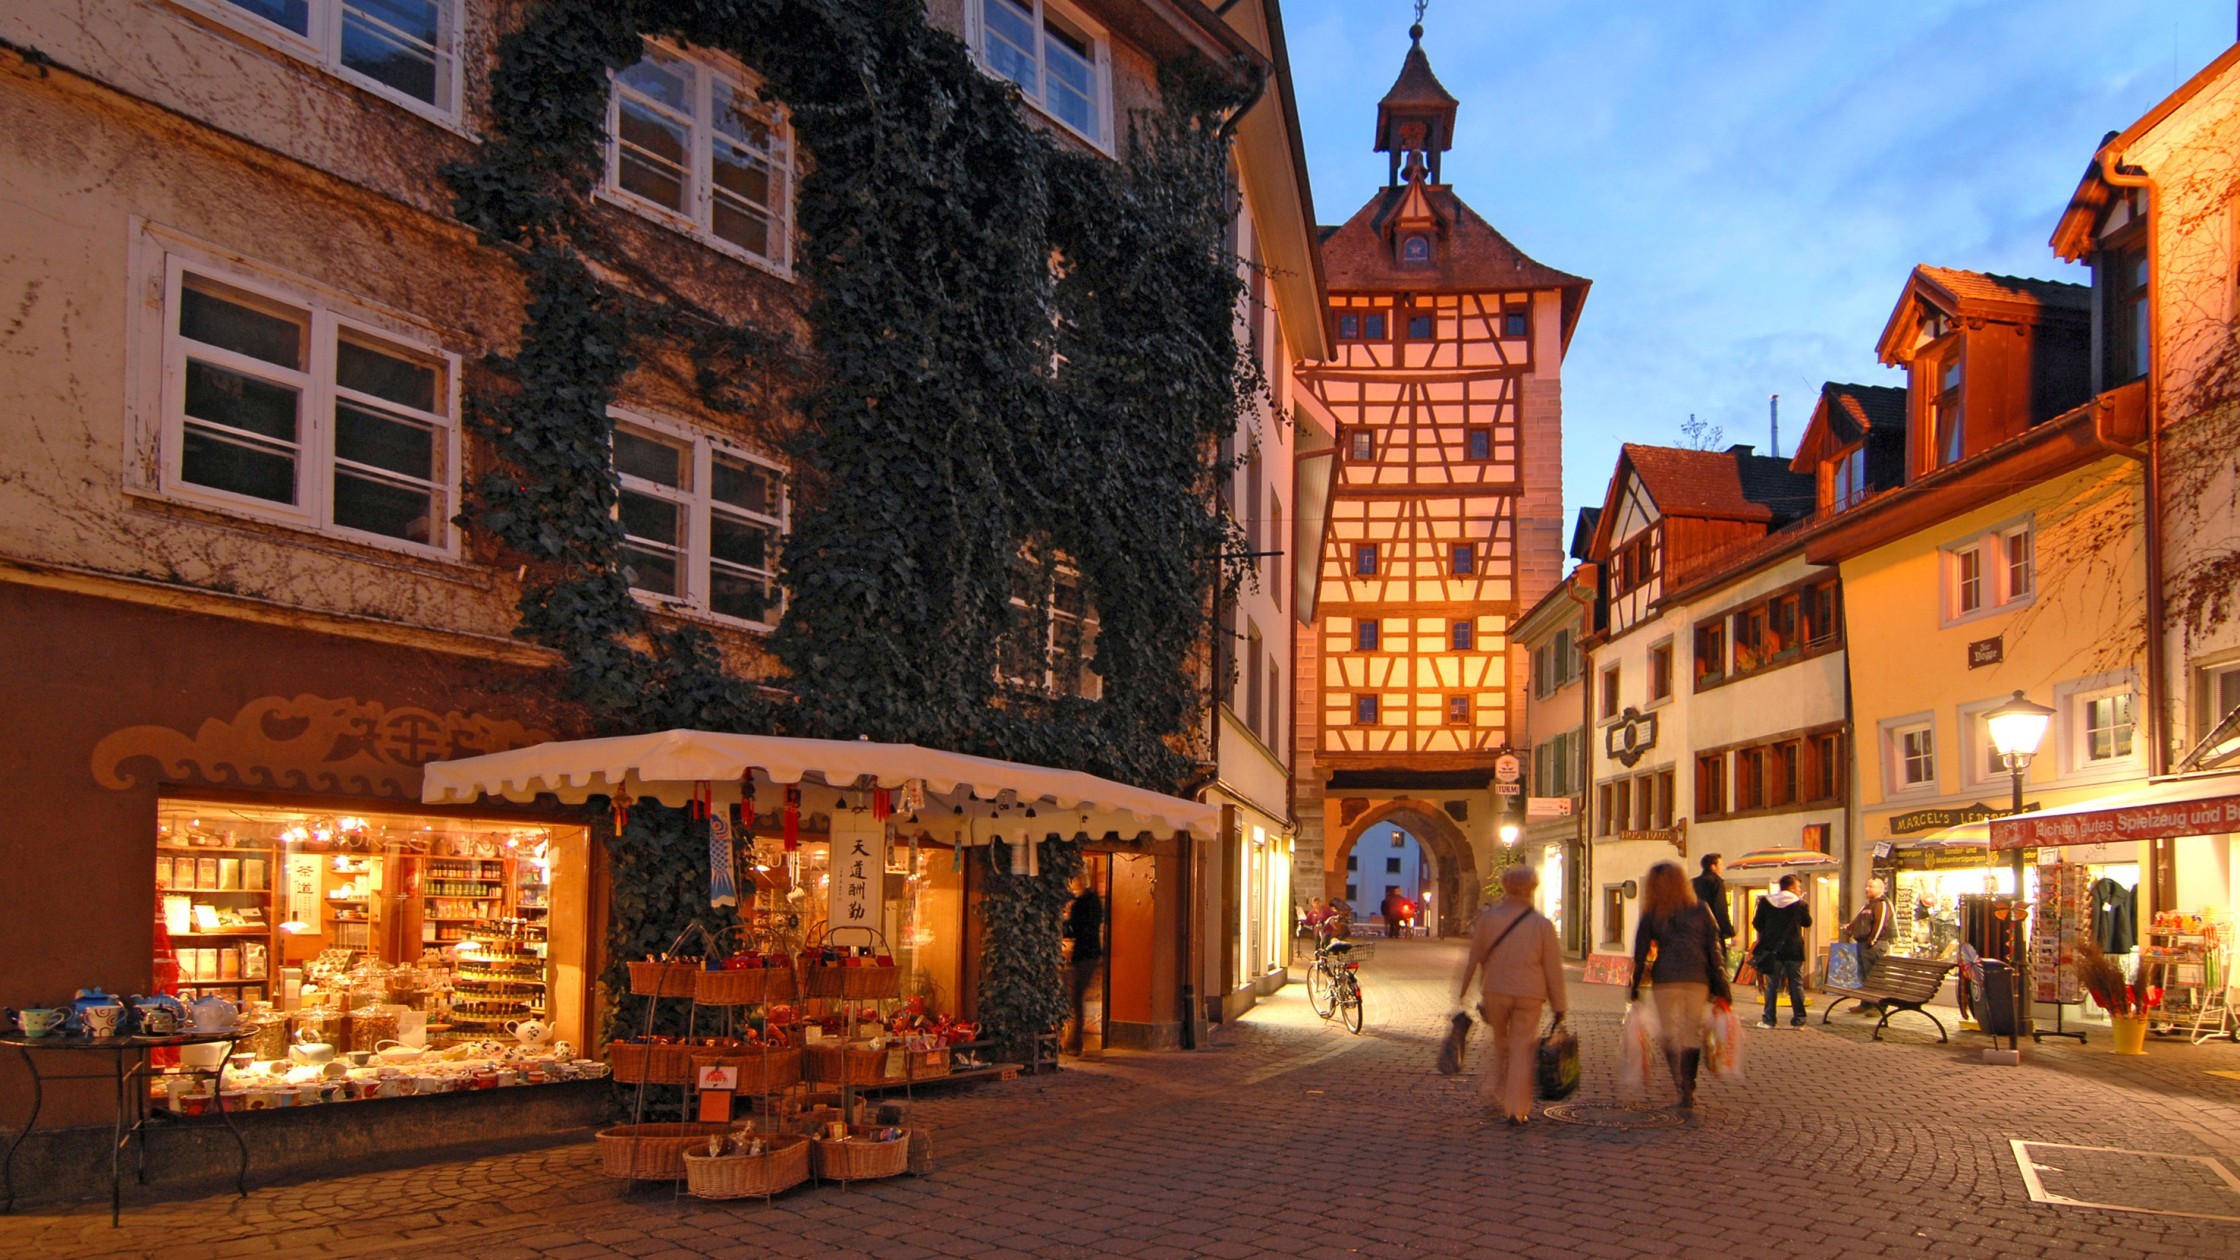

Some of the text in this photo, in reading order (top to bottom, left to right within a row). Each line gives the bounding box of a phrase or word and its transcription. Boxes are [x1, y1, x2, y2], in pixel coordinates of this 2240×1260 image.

[1498, 785, 1517, 794] TURM
[1897, 812, 1950, 830] MARCEL'S
[2036, 804, 2240, 838] Richtig gutes Spielzeug und B
[1646, 831, 1671, 840] HAUS
[296, 866, 315, 895] 茶道
[848, 839, 871, 921] 天道酬勤
